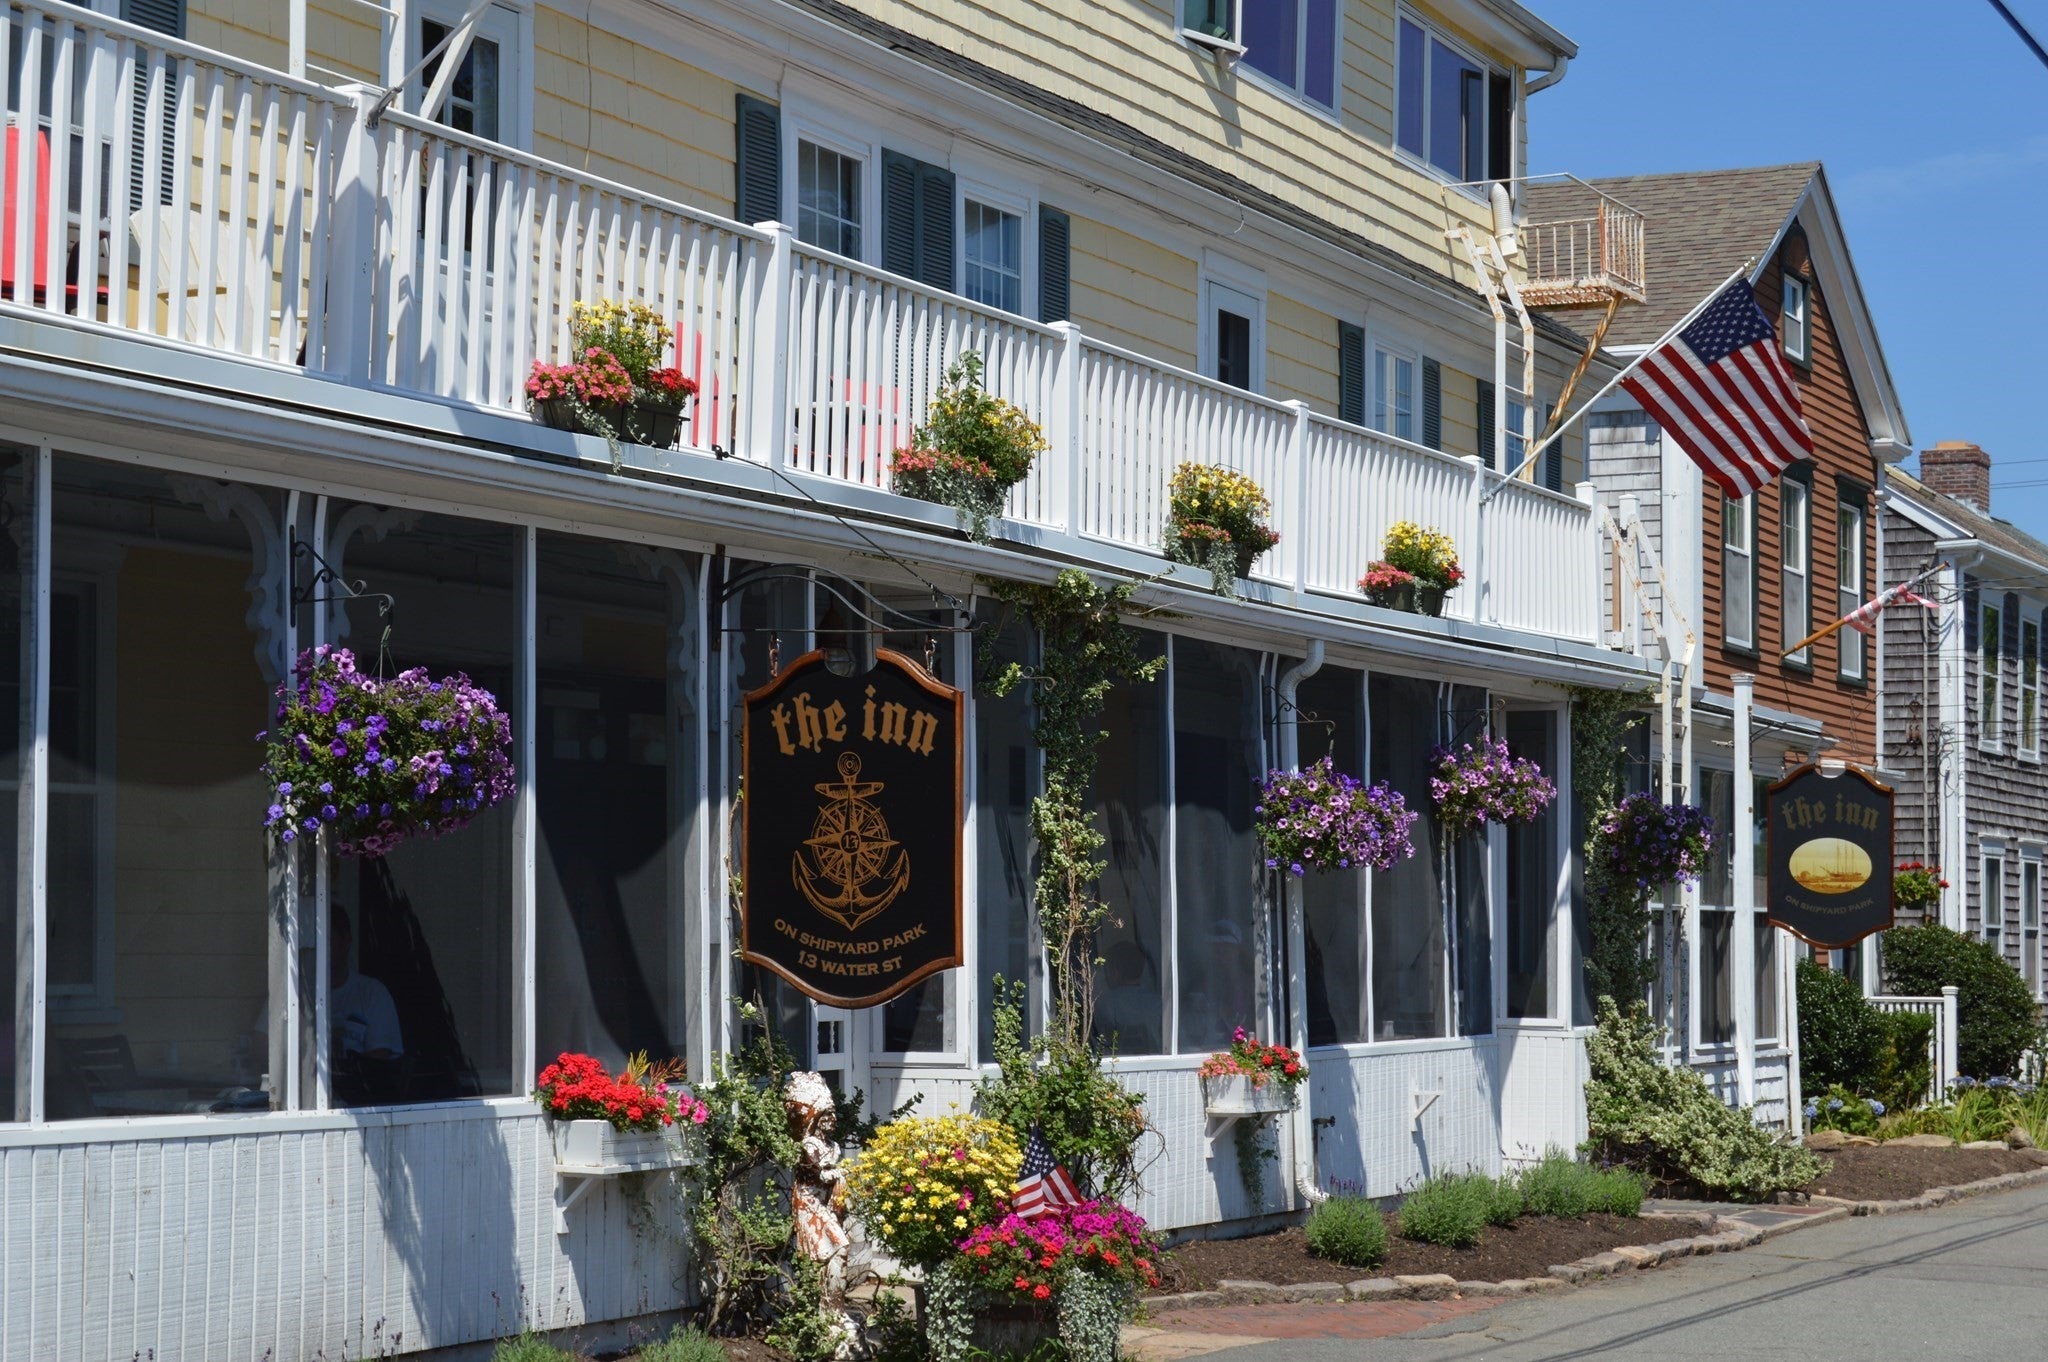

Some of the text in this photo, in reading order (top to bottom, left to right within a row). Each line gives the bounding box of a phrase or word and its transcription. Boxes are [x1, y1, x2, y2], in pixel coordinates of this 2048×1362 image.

[771, 684, 939, 757] the inn
[1782, 793, 1879, 831] the inn
[1785, 895, 1874, 915] ON SHIPYARD PARK
[774, 918, 927, 954] ON SHIPYARD PARK
[798, 951, 902, 976] 13 WATER ST
